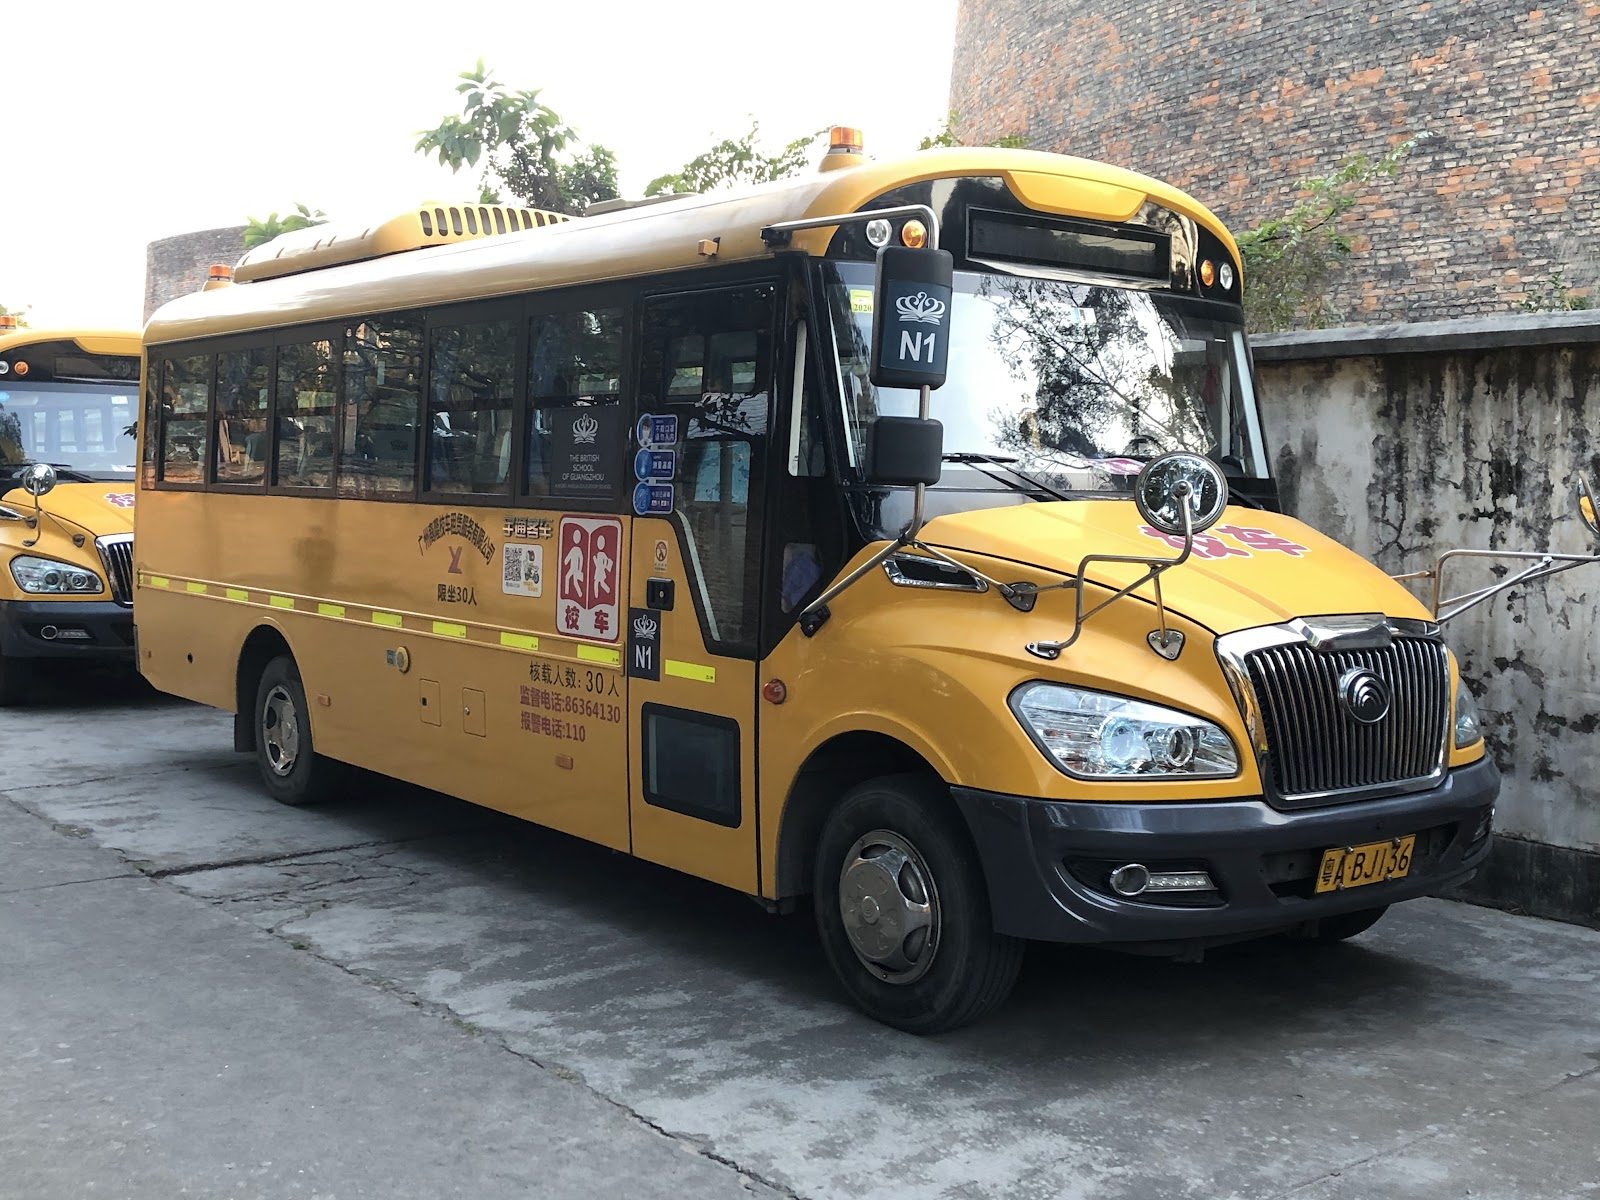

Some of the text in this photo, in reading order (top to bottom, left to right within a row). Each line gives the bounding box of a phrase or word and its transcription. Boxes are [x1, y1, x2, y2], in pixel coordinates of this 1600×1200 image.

[853, 303, 872, 312] 2020
[899, 330, 936, 363] N1
[569, 454, 600, 462] THE BRITISH
[572, 464, 594, 472] SCHOOL
[562, 473, 605, 481] OF GUANGZHOU
[437, 583, 478, 607] 限坐30人
[564, 604, 610, 634] 校车
[635, 645, 652, 670] N1
[519, 684, 621, 724] 监督电话:86364130
[520, 711, 586, 742] 报警电话:110
